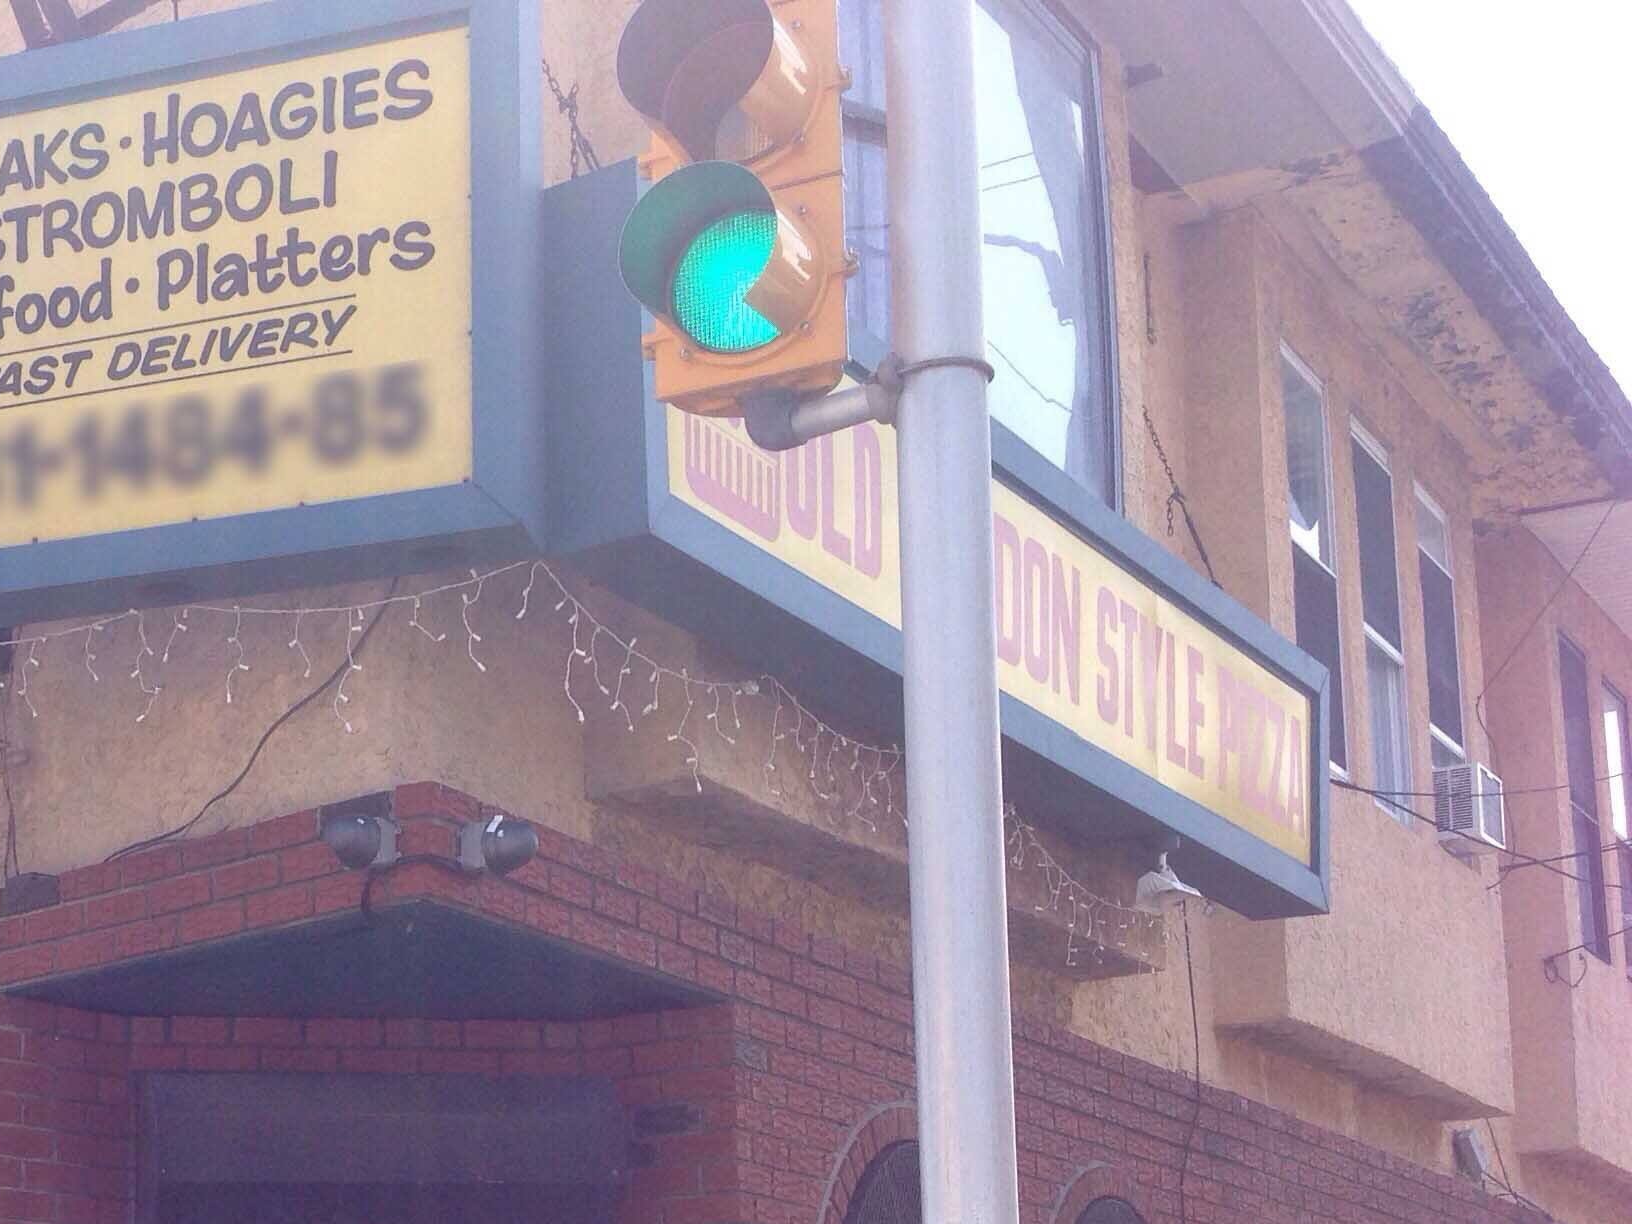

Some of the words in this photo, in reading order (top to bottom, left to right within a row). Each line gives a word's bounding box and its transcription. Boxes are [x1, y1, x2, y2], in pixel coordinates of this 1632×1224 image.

[143, 59, 434, 168] HOAGIES
[157, 220, 436, 310] Platters
[107, 303, 357, 380] DELIVERY
[993, 511, 1080, 706] DON
[1097, 586, 1204, 780] STYLE
[1218, 664, 1306, 842] PIZZA
